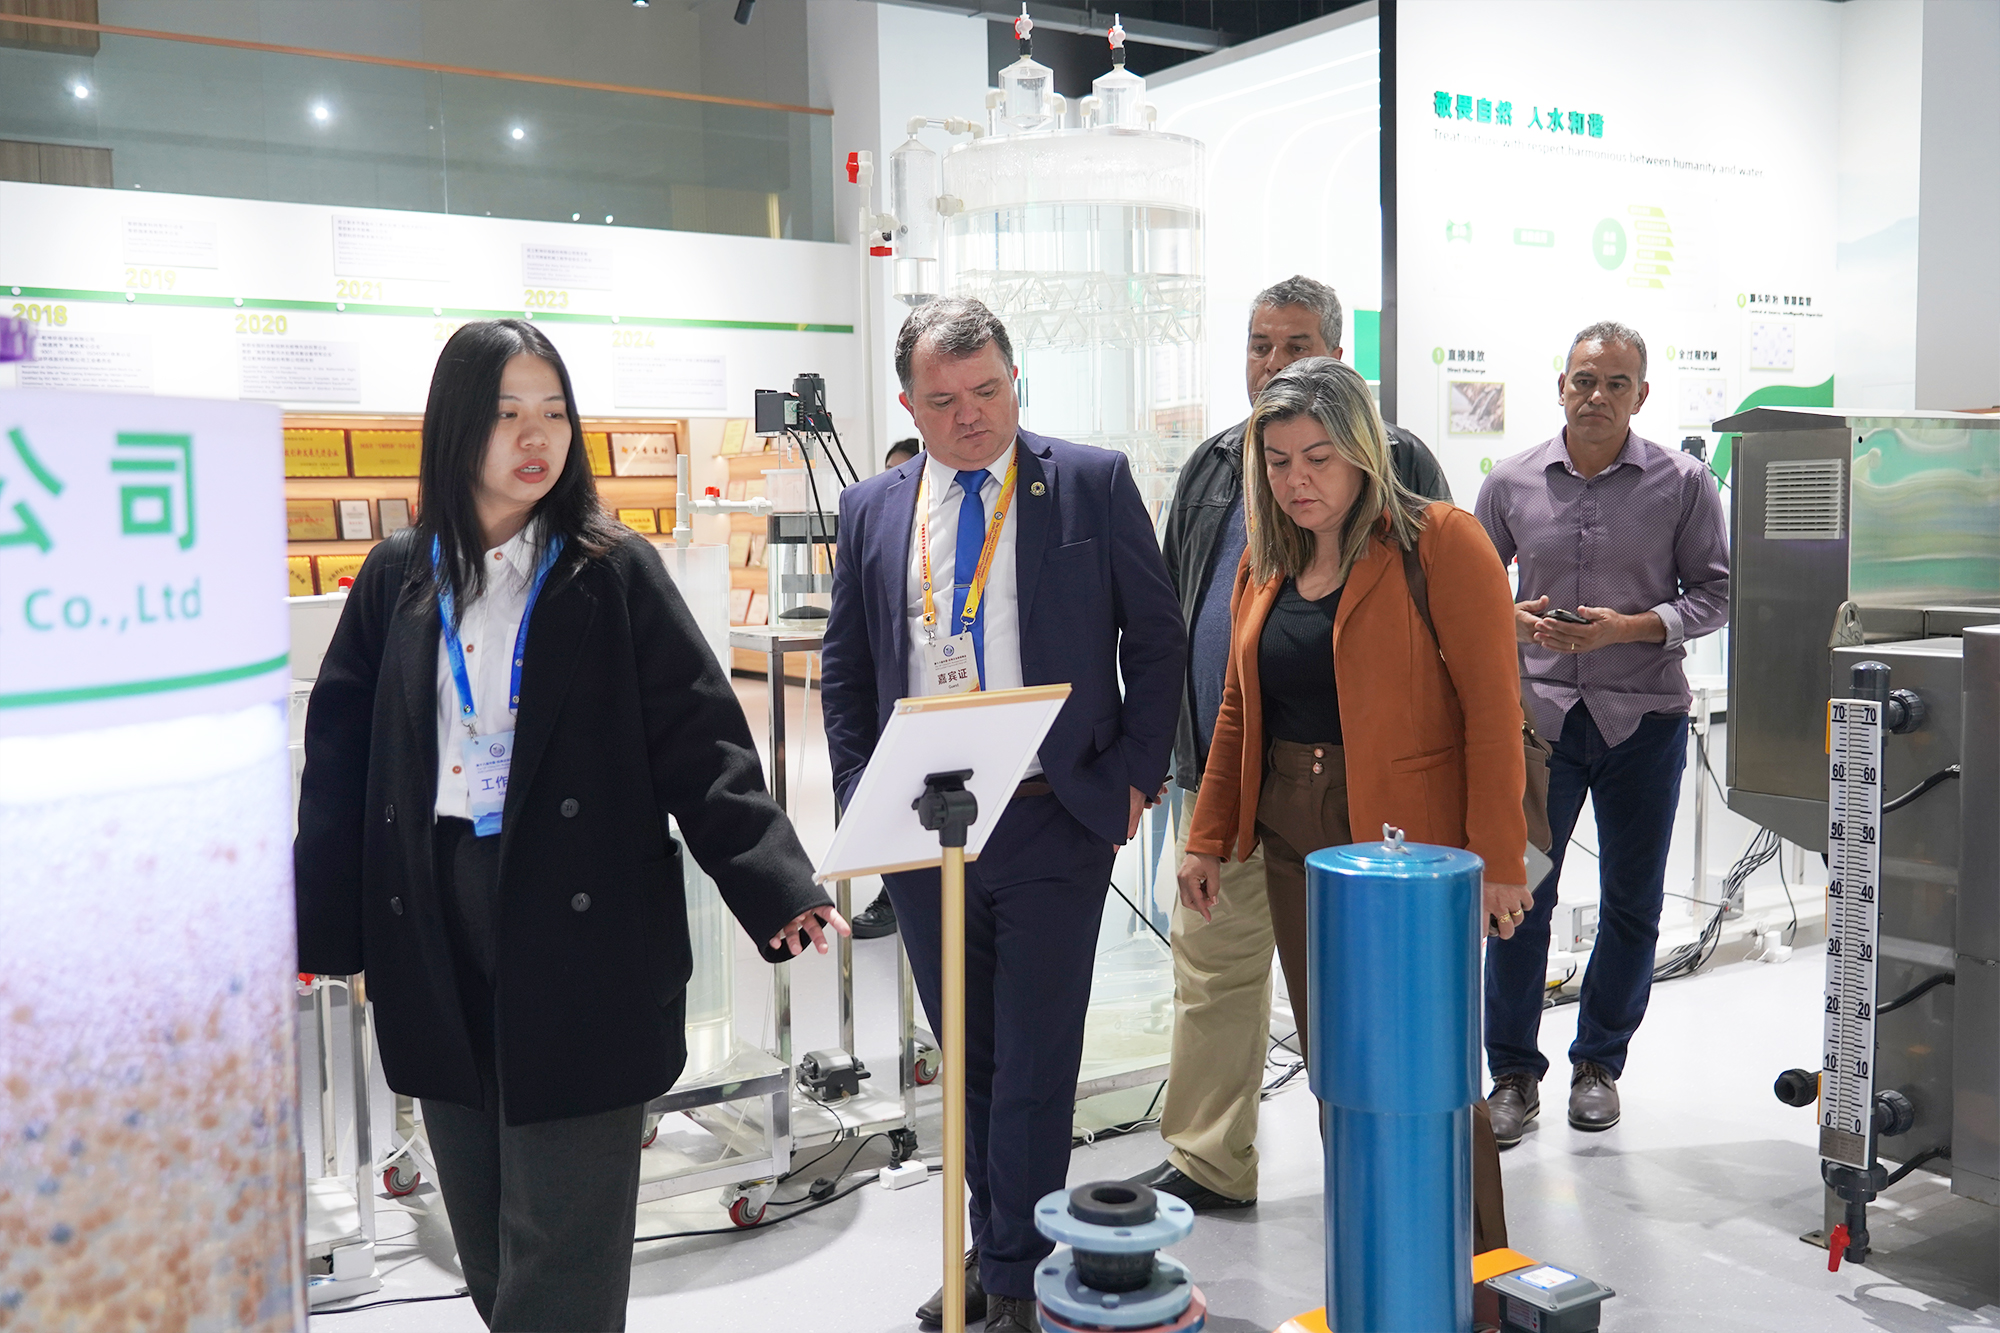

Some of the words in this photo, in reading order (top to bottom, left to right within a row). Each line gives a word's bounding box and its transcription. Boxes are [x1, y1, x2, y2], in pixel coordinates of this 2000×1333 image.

[1433, 90, 1513, 127] 敬畏自然
[1528, 105, 1605, 139] 人水和谐
[1433, 128, 1460, 142] Treat
[1629, 151, 1671, 169] between
[1673, 157, 1717, 175] humanity
[1719, 165, 1736, 175] and
[125, 267, 177, 290] 2019
[336, 279, 383, 300] 2021
[524, 289, 569, 309] 2023
[12, 302, 68, 327] 2018
[235, 313, 288, 335] 2020
[612, 329, 656, 348] 2024
[1447, 348, 1486, 363] 直接排放
[937, 668, 968, 686] 嘉宾证
[1832, 706, 1845, 720] 70
[1864, 708, 1876, 722] 70
[1832, 764, 1844, 778] 60
[1863, 766, 1875, 781] 60
[1831, 822, 1843, 837] 50
[1862, 826, 1874, 840] 50
[1829, 881, 1842, 895] 40
[1861, 885, 1874, 899] 40
[1828, 939, 1840, 953] 30
[1860, 944, 1872, 958] 30
[1827, 997, 1839, 1011] 20
[1858, 1002, 1870, 1017] 20
[1825, 1054, 1836, 1069] 10
[1856, 1060, 1867, 1075] 10
[1825, 1112, 1831, 1126] 0
[1855, 1119, 1861, 1133] 0
